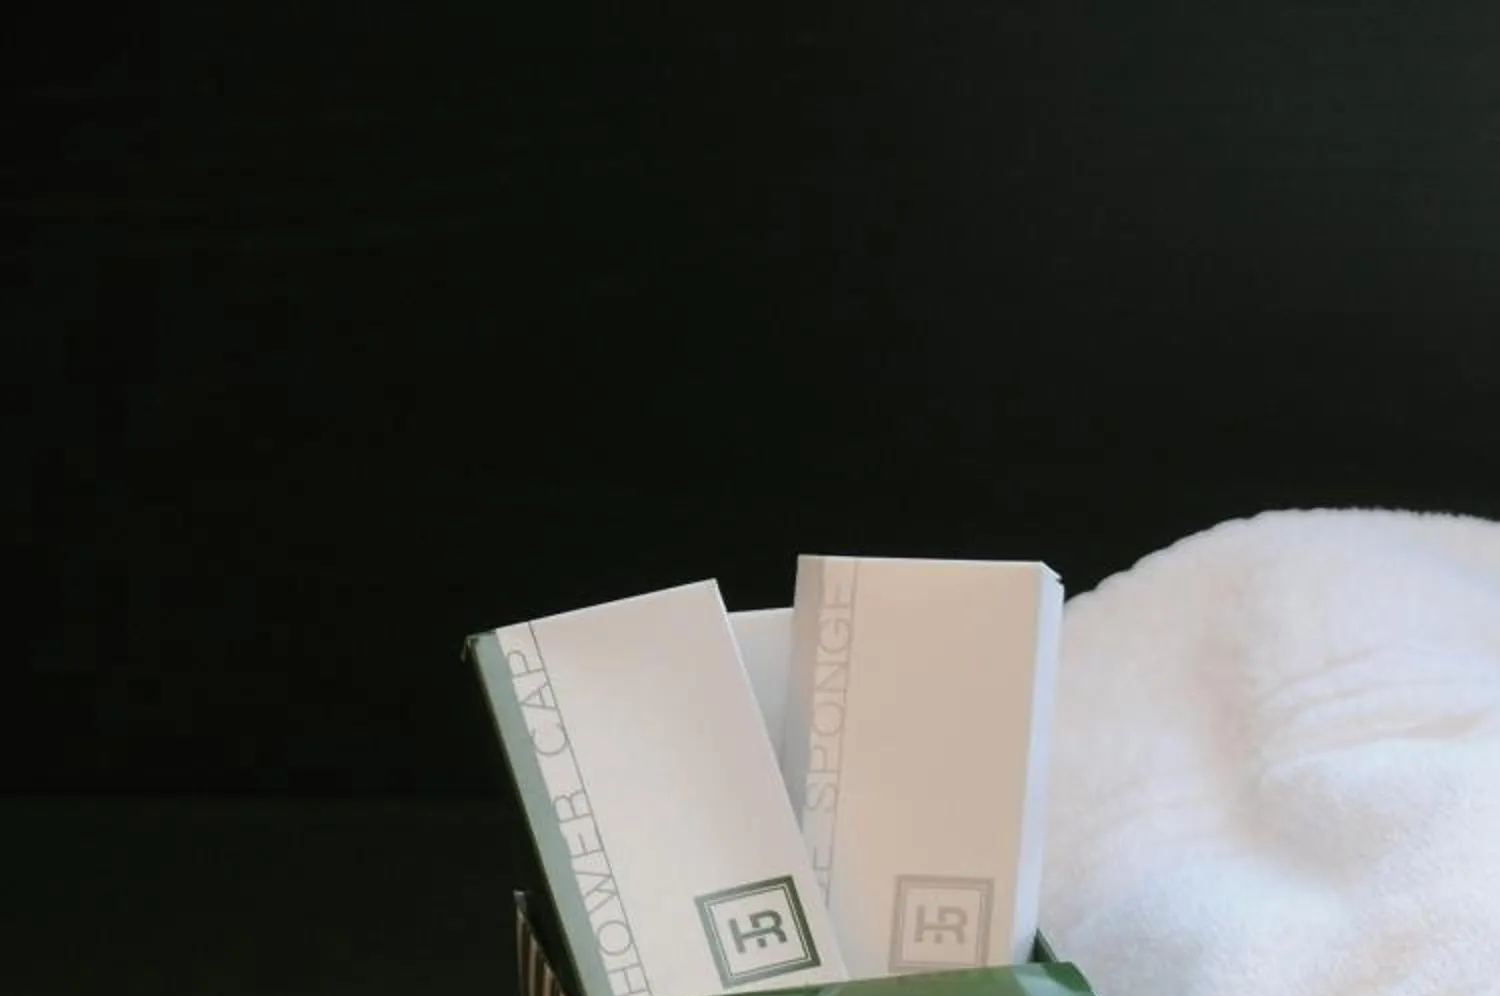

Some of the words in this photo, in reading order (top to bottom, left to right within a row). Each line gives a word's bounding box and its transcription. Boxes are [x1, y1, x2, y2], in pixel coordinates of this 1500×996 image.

[506, 650, 568, 757] CAP
[805, 580, 854, 815] SPONGE
[728, 909, 788, 954] HR
[913, 904, 968, 944] HR
